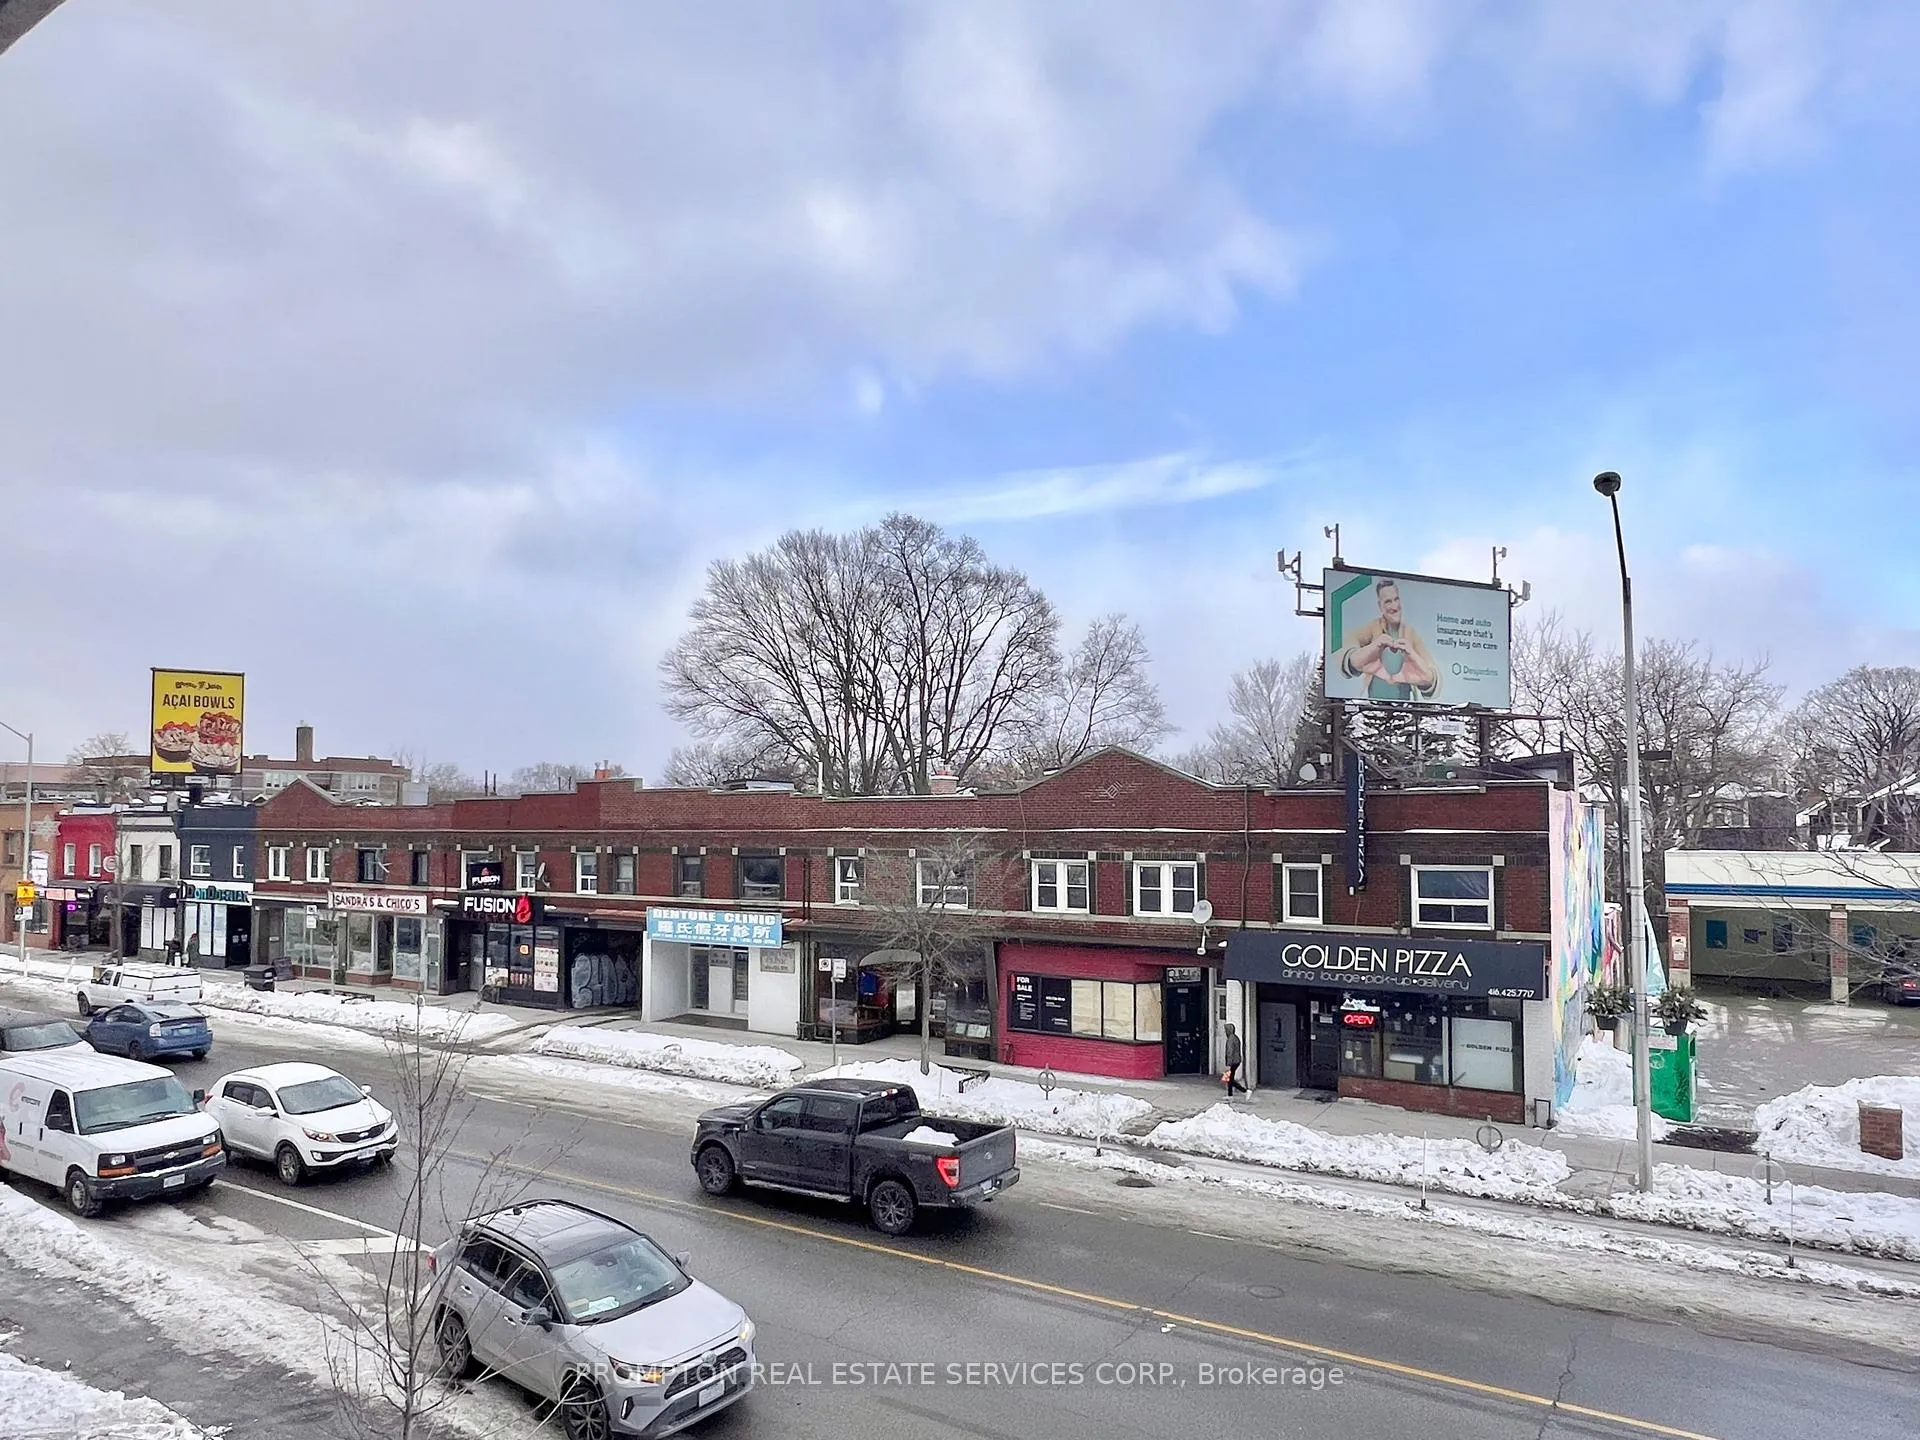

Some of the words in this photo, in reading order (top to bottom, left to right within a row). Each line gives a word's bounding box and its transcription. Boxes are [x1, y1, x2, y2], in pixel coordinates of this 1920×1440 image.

[1436, 612, 1459, 624] Home
[1460, 617, 1474, 625] and
[1475, 619, 1492, 627] auto
[1436, 624, 1472, 637] insurance
[1473, 629, 1493, 639] that's
[1436, 638, 1457, 648] really
[1458, 639, 1471, 650] big
[162, 693, 191, 709] AÇAI
[193, 695, 235, 709] BOWLS
[472, 875, 501, 884] FUSION
[377, 895, 384, 908] &
[385, 897, 420, 910] CHICO'S
[464, 896, 516, 913] FUSION
[652, 908, 716, 921] DENTURE
[724, 912, 776, 926] CLINIC
[1281, 943, 1388, 972] GOLDEN
[1395, 949, 1472, 977] PIZZA
[1282, 968, 1315, 981] dining
[1320, 970, 1361, 983] lounge
[1016, 984, 1032, 992] SALE
[1344, 1014, 1374, 1025] OPEN
